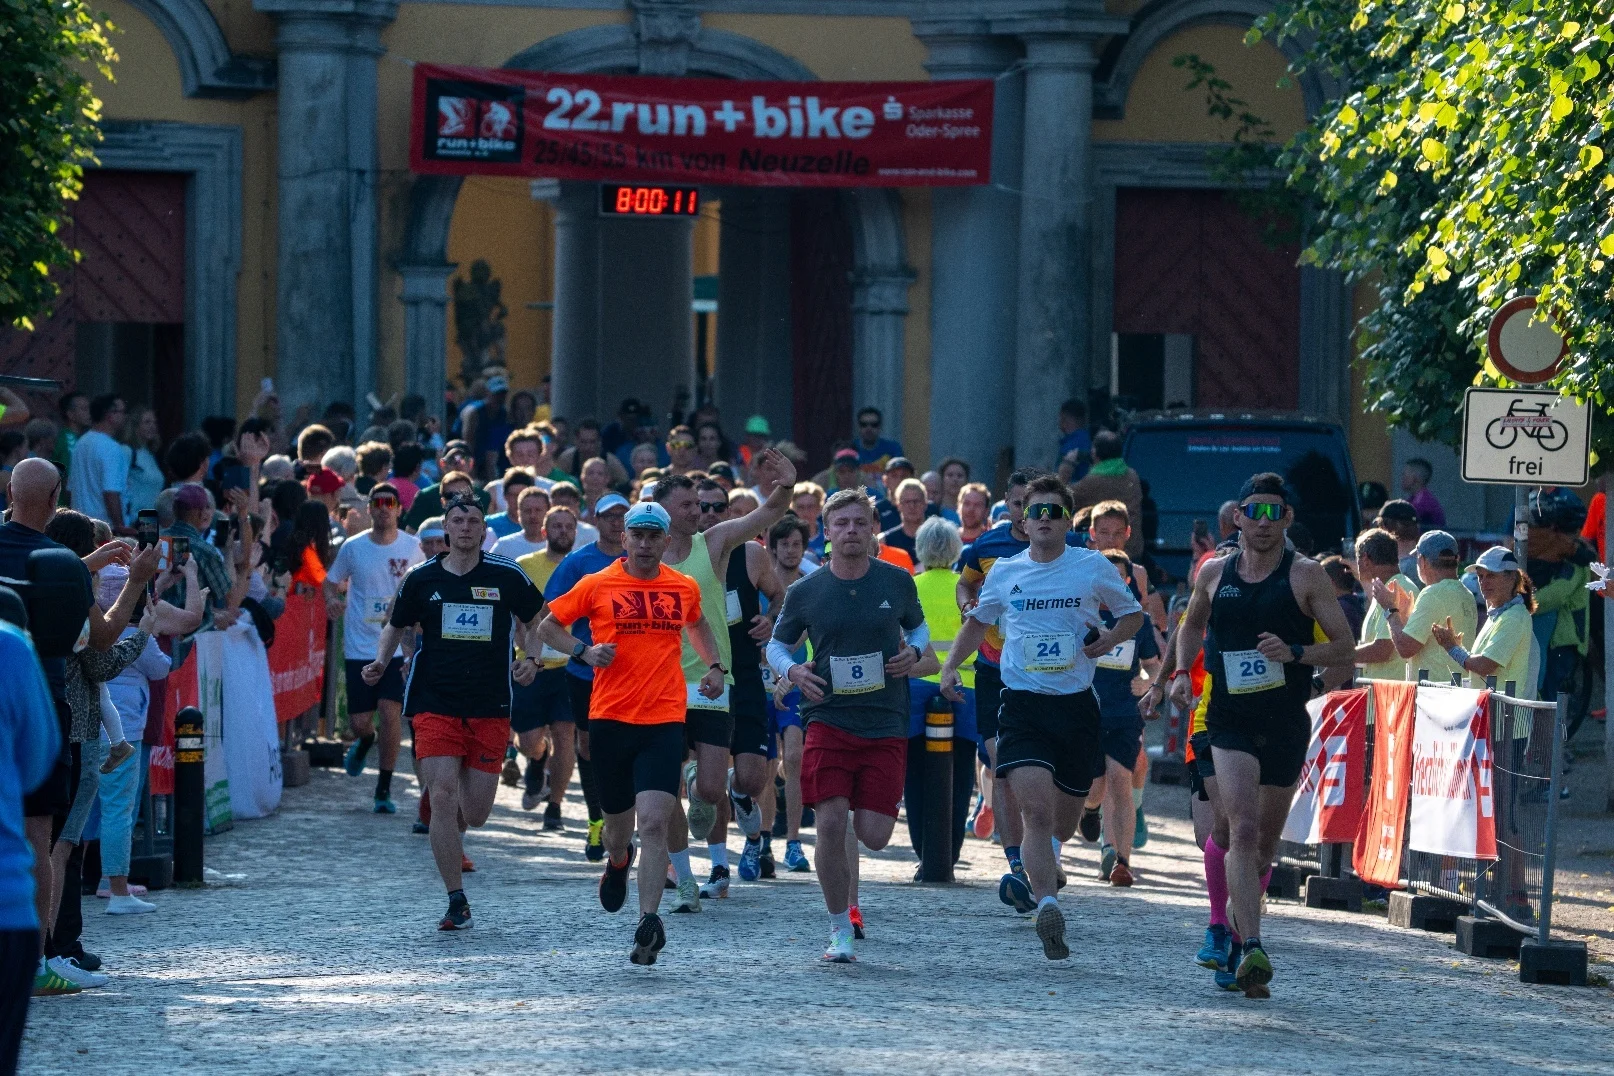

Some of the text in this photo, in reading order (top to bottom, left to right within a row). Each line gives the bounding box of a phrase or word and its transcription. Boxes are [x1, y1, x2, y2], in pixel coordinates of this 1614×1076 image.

[908, 106, 974, 120] Sparkasse
[906, 123, 980, 139] Oder-Spree
[636, 144, 674, 169] km
[679, 150, 725, 171] von
[738, 148, 870, 175] Neuzelle
[616, 187, 697, 214] 8:00:11
[1509, 456, 1543, 475] frei
[1026, 597, 1081, 611] Hermes
[456, 612, 479, 627] 44
[1037, 641, 1061, 658] 24
[851, 664, 864, 680] 8
[1240, 659, 1267, 677] 26
